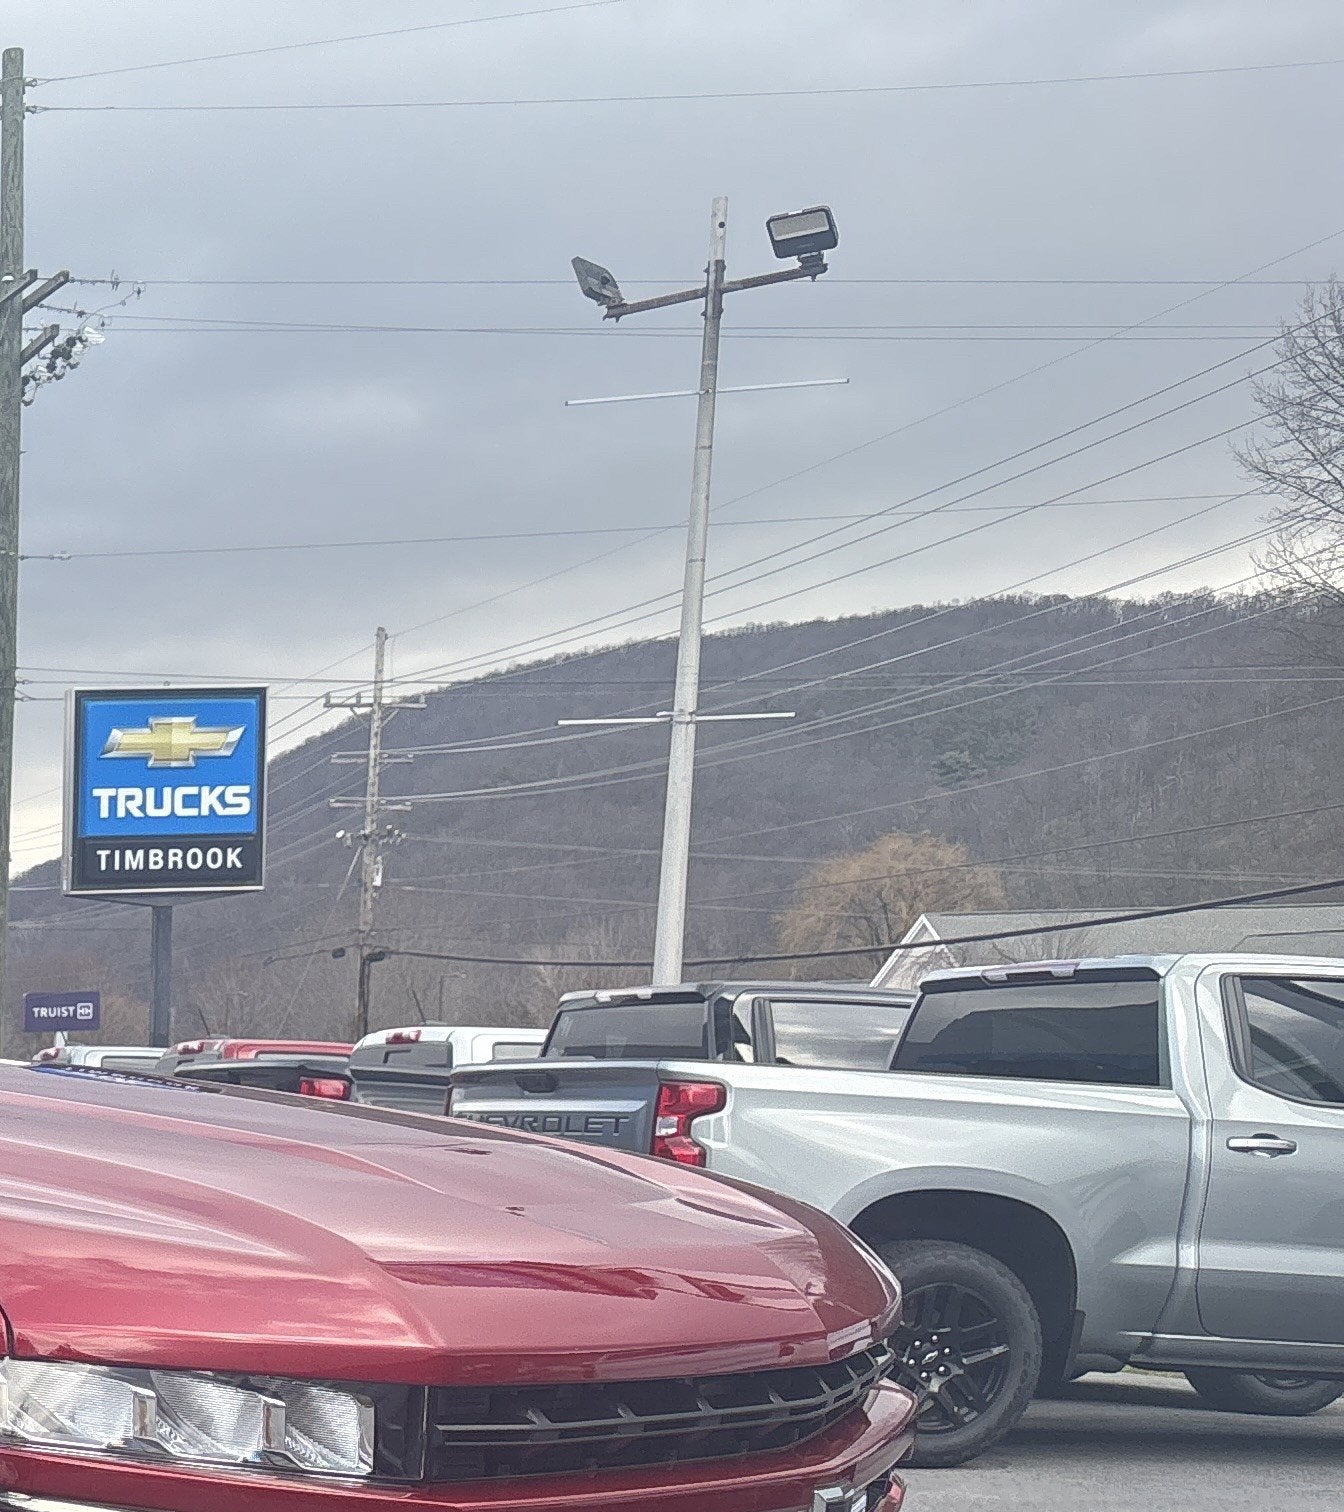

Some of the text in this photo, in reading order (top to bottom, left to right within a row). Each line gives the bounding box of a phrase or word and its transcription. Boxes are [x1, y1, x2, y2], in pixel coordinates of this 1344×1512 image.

[92, 785, 251, 818] TRUCKS
[96, 847, 243, 871] TIMBROOK
[32, 1004, 75, 1018] TRUIST
[455, 1114, 630, 1137] EVROLET
